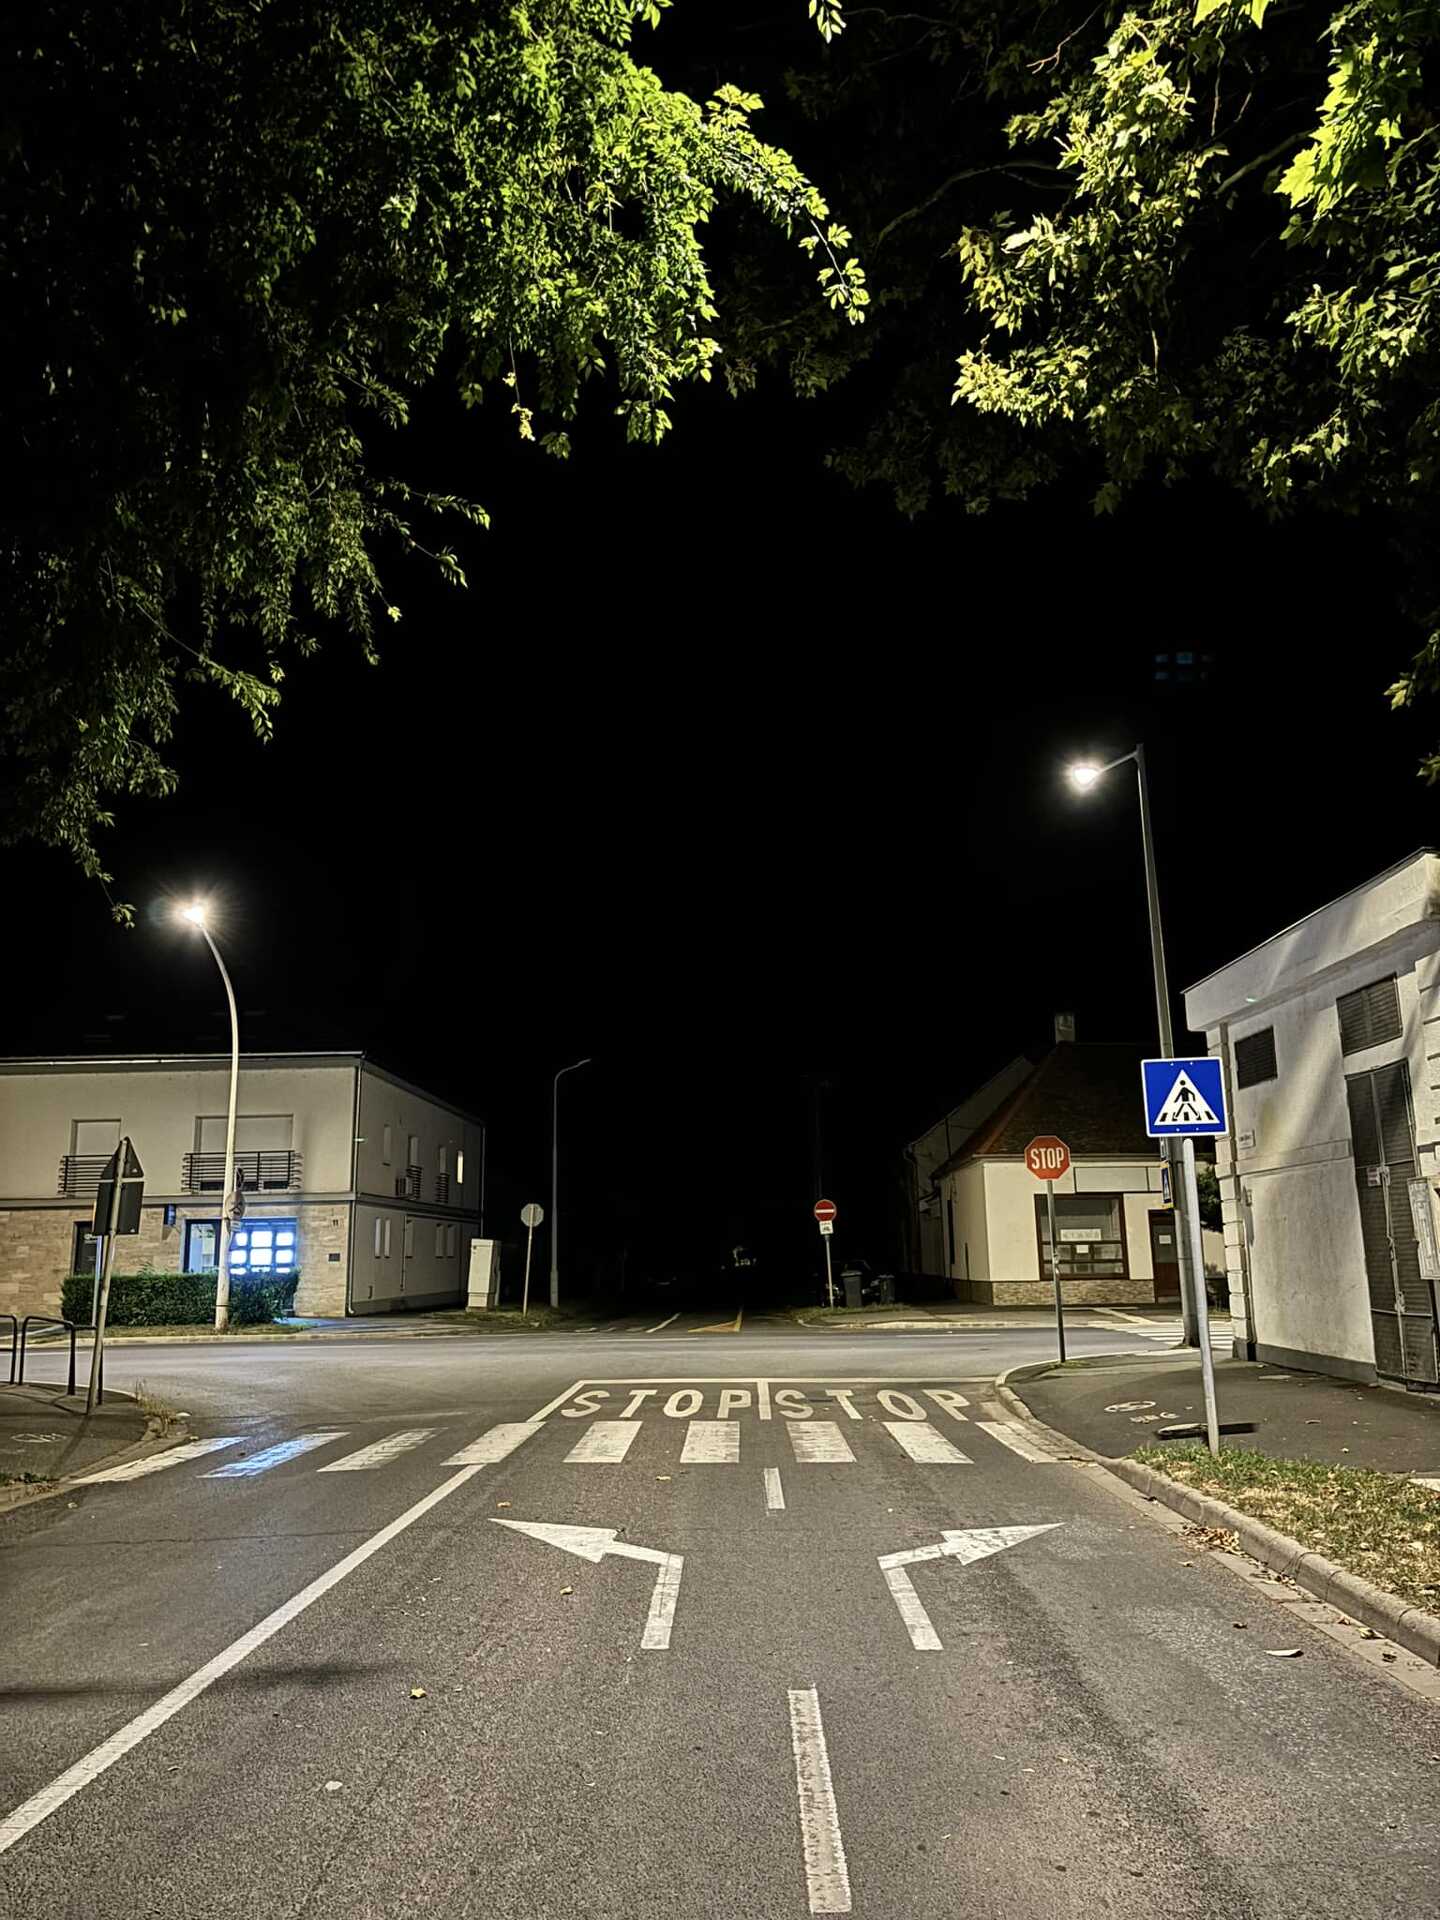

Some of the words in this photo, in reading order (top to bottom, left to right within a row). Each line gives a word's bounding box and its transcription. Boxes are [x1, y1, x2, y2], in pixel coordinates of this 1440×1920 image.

[1031, 1147, 1064, 1169] STOP
[561, 1389, 751, 1418] STOP
[775, 1389, 971, 1421] STOP
